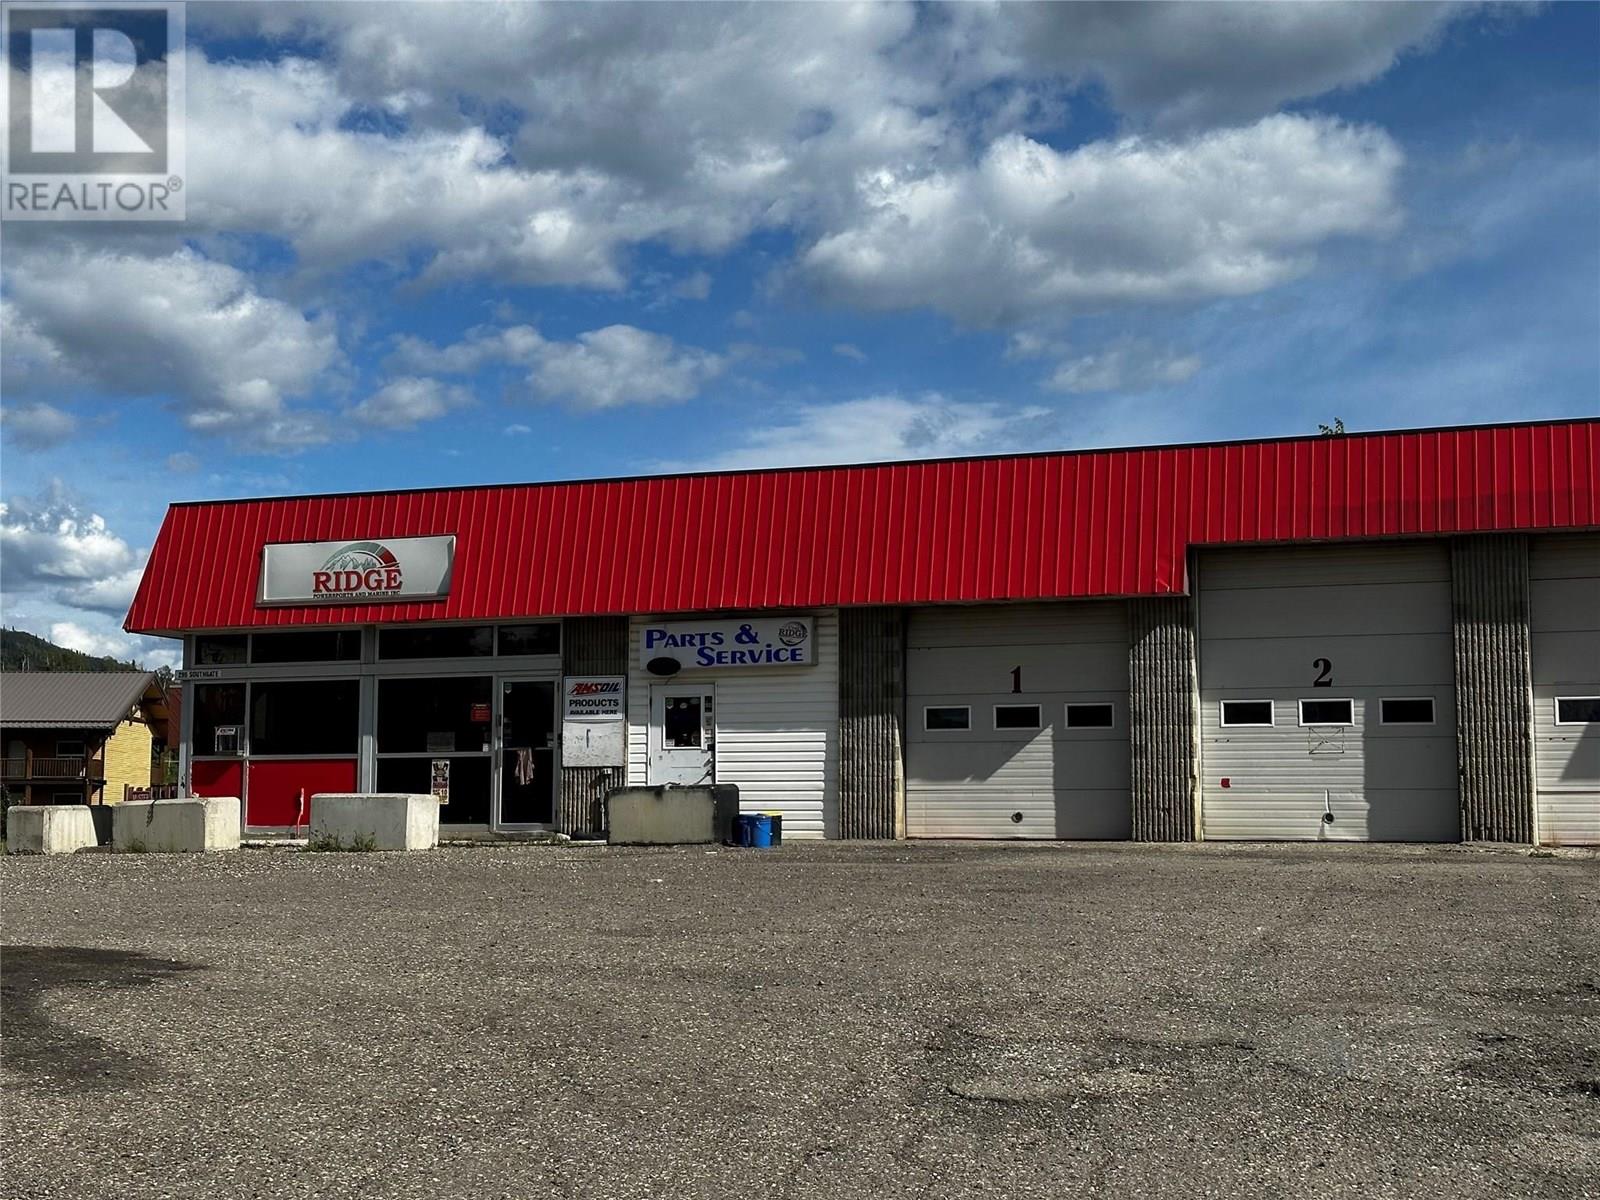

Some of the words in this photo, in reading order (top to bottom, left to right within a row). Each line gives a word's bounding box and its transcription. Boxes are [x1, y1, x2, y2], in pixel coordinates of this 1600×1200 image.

[312, 568, 403, 593] RIDGE
[734, 624, 760, 645] &
[778, 627, 808, 639] RIDGE
[1010, 665, 1022, 694] 1
[1312, 657, 1333, 688] 2
[570, 682, 620, 695] AMSOIL
[569, 699, 619, 707] PRODUCTS
